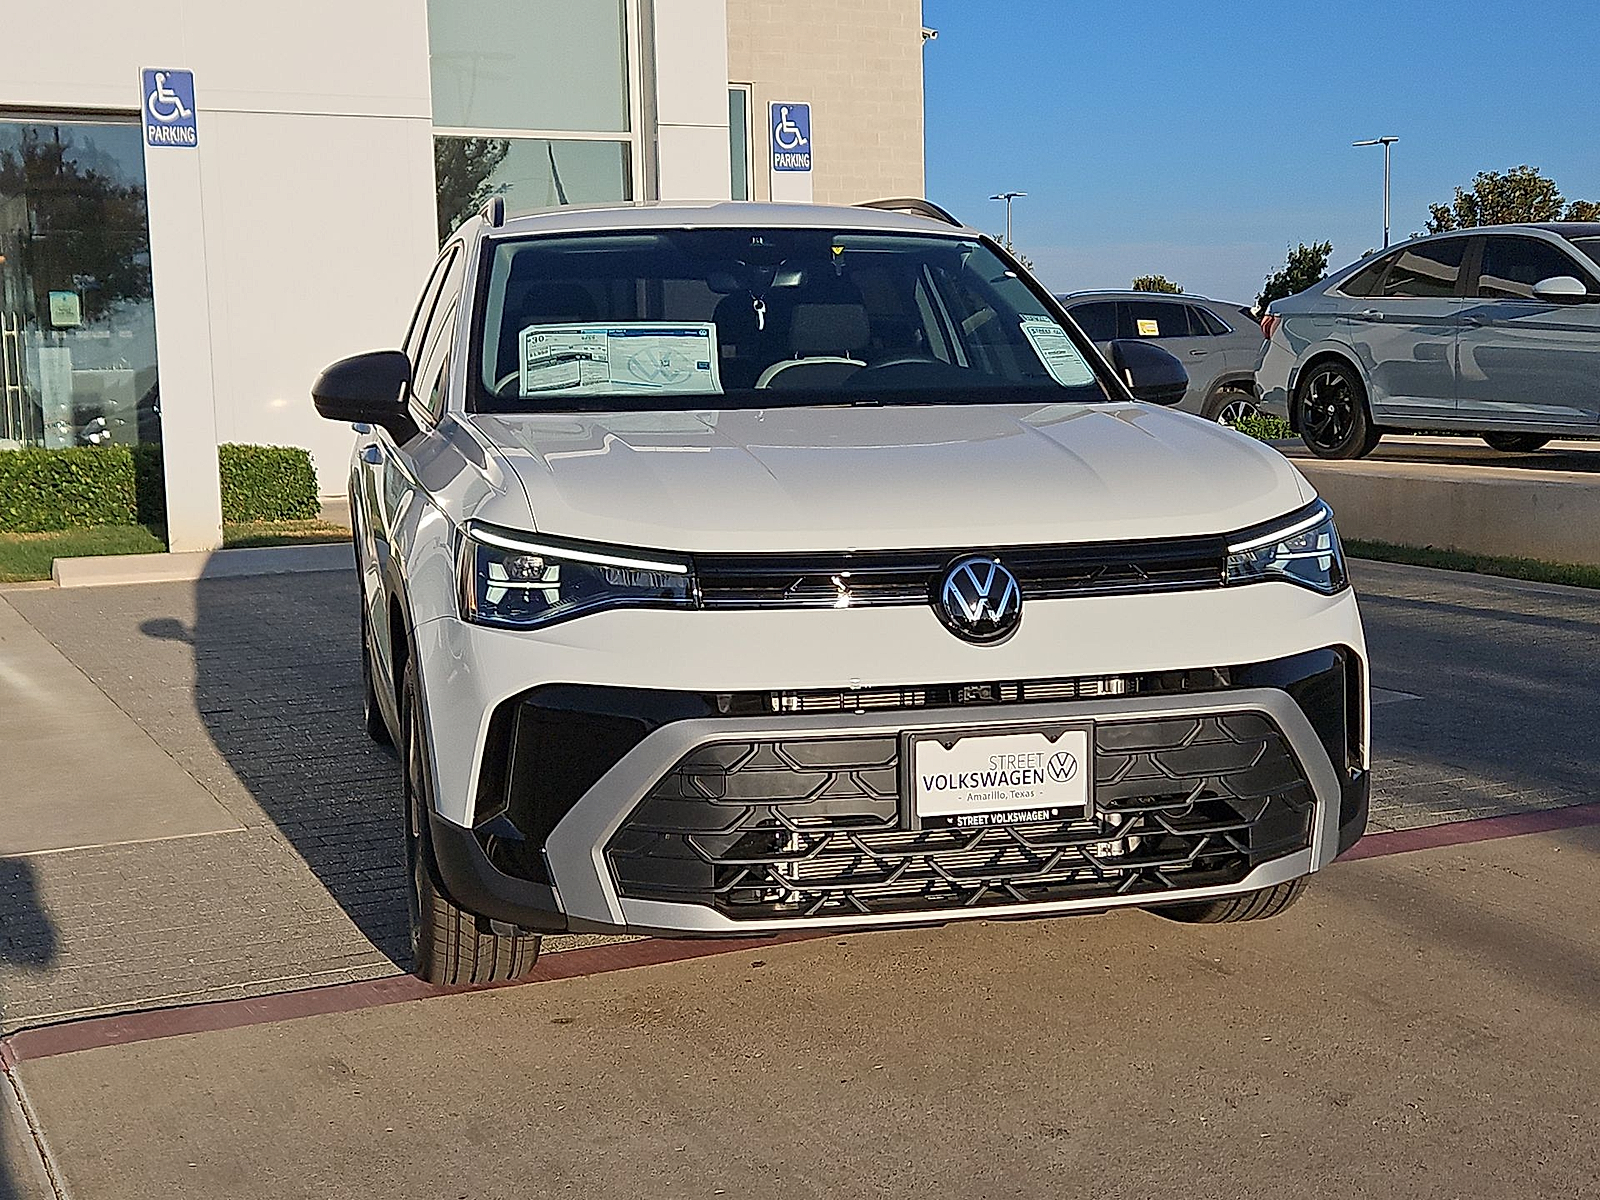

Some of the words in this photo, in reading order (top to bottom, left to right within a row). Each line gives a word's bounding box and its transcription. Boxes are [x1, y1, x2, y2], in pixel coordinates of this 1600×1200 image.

[148, 125, 196, 143] PARKING
[774, 153, 810, 168] PARKING
[989, 753, 1045, 771] STREET
[923, 768, 1045, 791] VOLKSWAGEN
[966, 791, 1008, 801] Amarillo,
[1010, 789, 1035, 799] Texas
[957, 815, 989, 827] STREET
[990, 810, 1050, 824] VOLKSWAGEN
